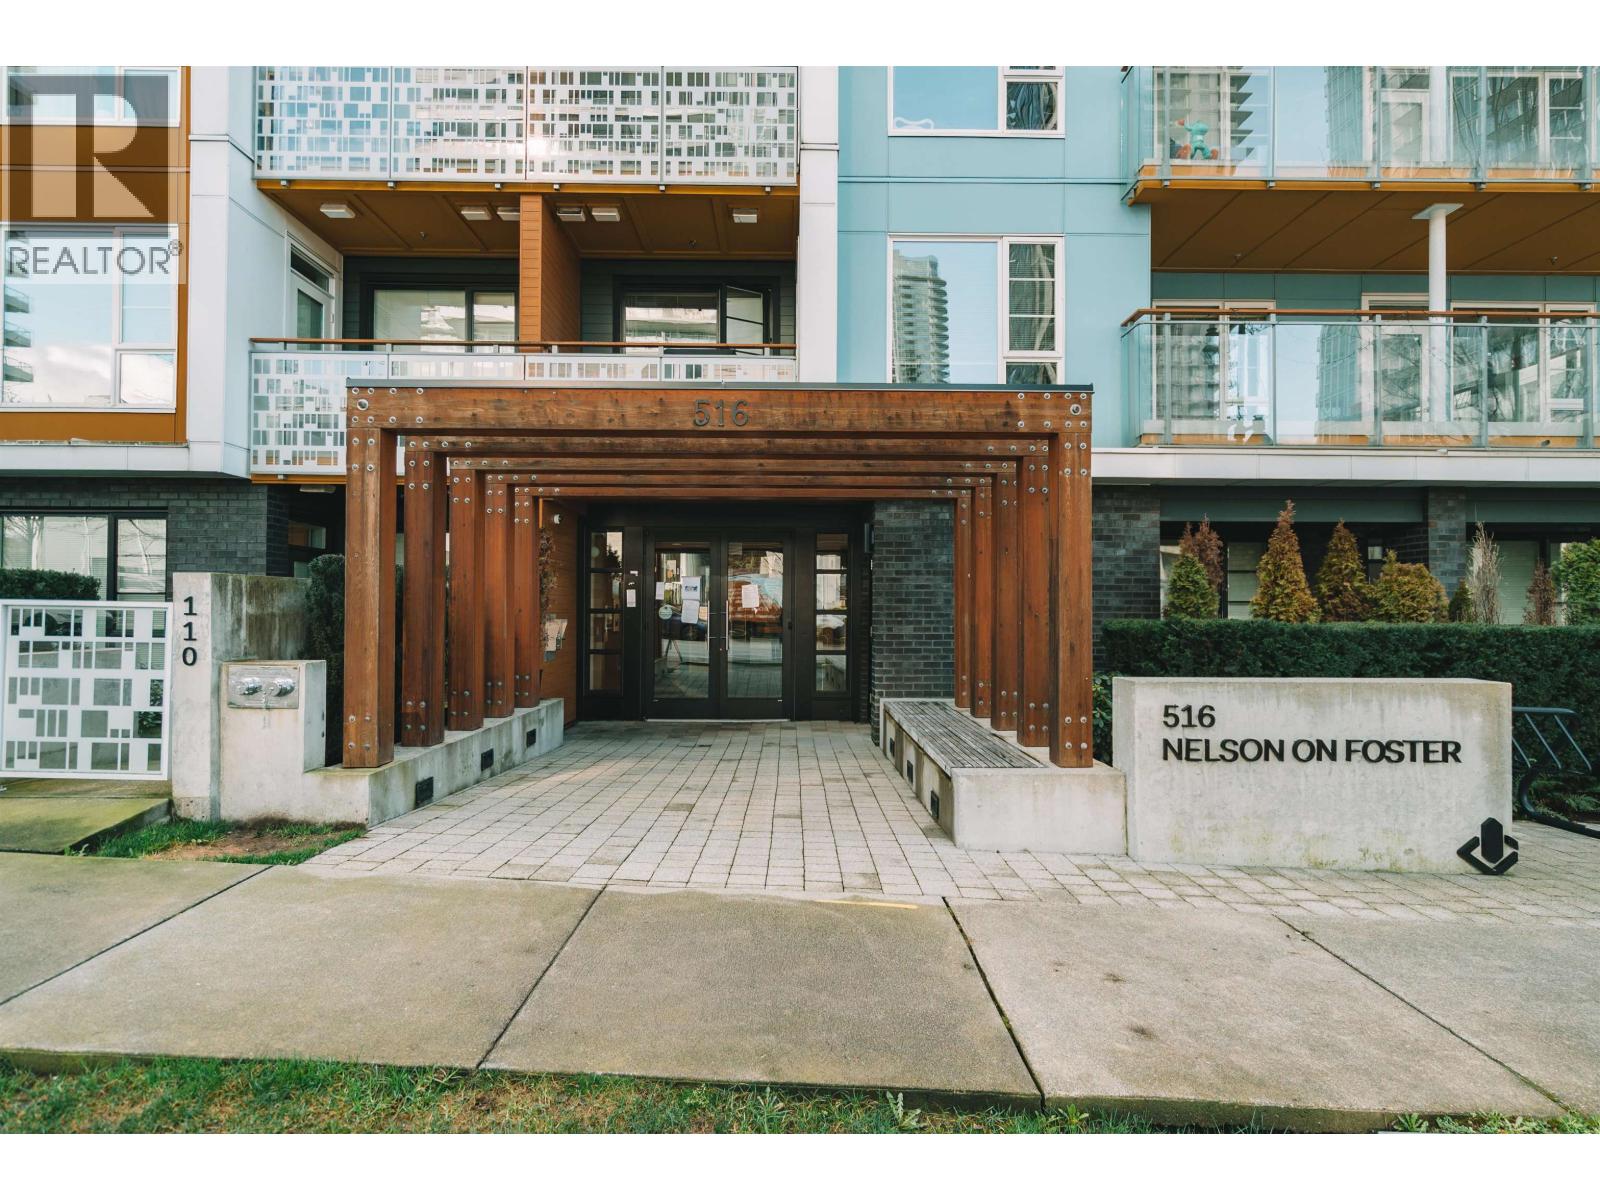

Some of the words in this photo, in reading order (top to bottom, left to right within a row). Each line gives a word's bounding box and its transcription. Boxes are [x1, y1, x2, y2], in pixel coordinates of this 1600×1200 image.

[693, 399, 750, 427] 516
[182, 595, 198, 667] 110
[1162, 704, 1216, 728] 516
[1162, 738, 1285, 762] NELSON
[1292, 739, 1337, 763] ON
[1345, 739, 1462, 764] FOSTER
